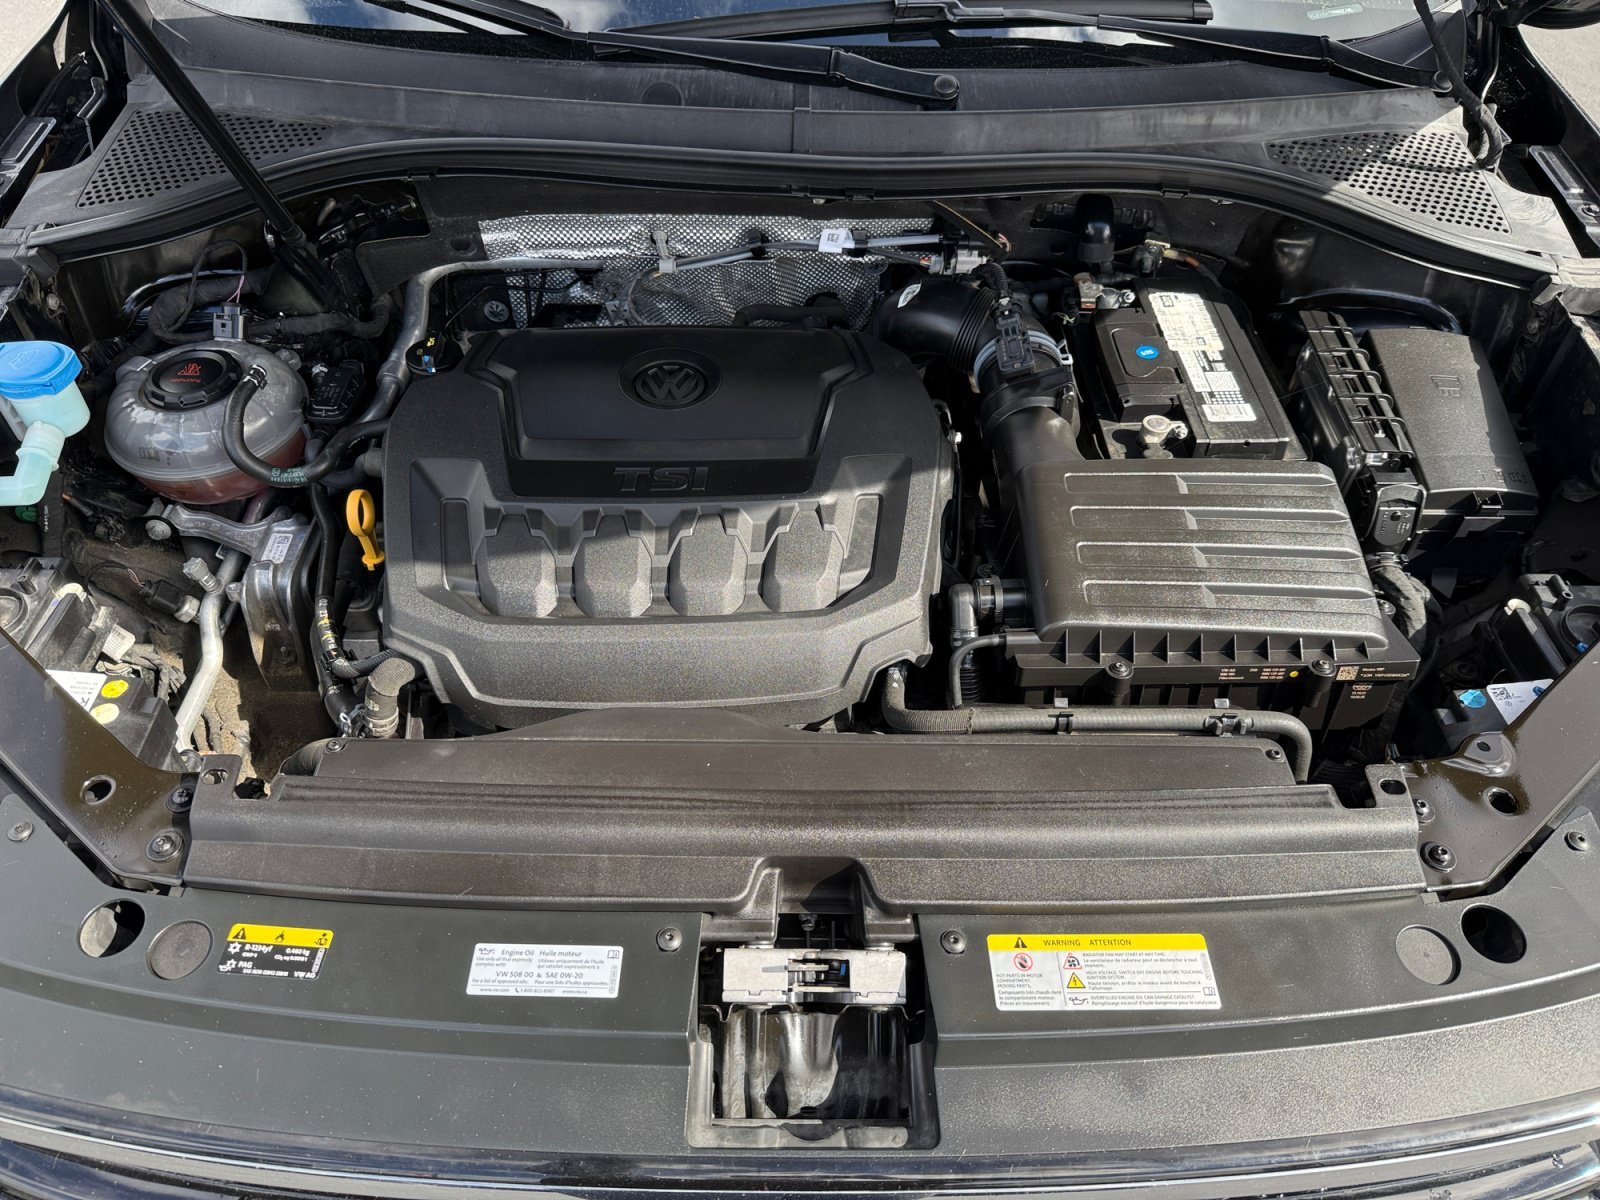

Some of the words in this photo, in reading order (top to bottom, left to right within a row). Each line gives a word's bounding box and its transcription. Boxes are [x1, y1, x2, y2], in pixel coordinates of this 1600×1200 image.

[635, 360, 706, 406] VW
[613, 467, 708, 492] TSI
[1043, 939, 1080, 947] WARNING
[501, 949, 523, 958] Engine
[525, 949, 534, 957] Oil
[238, 961, 253, 969] PAG
